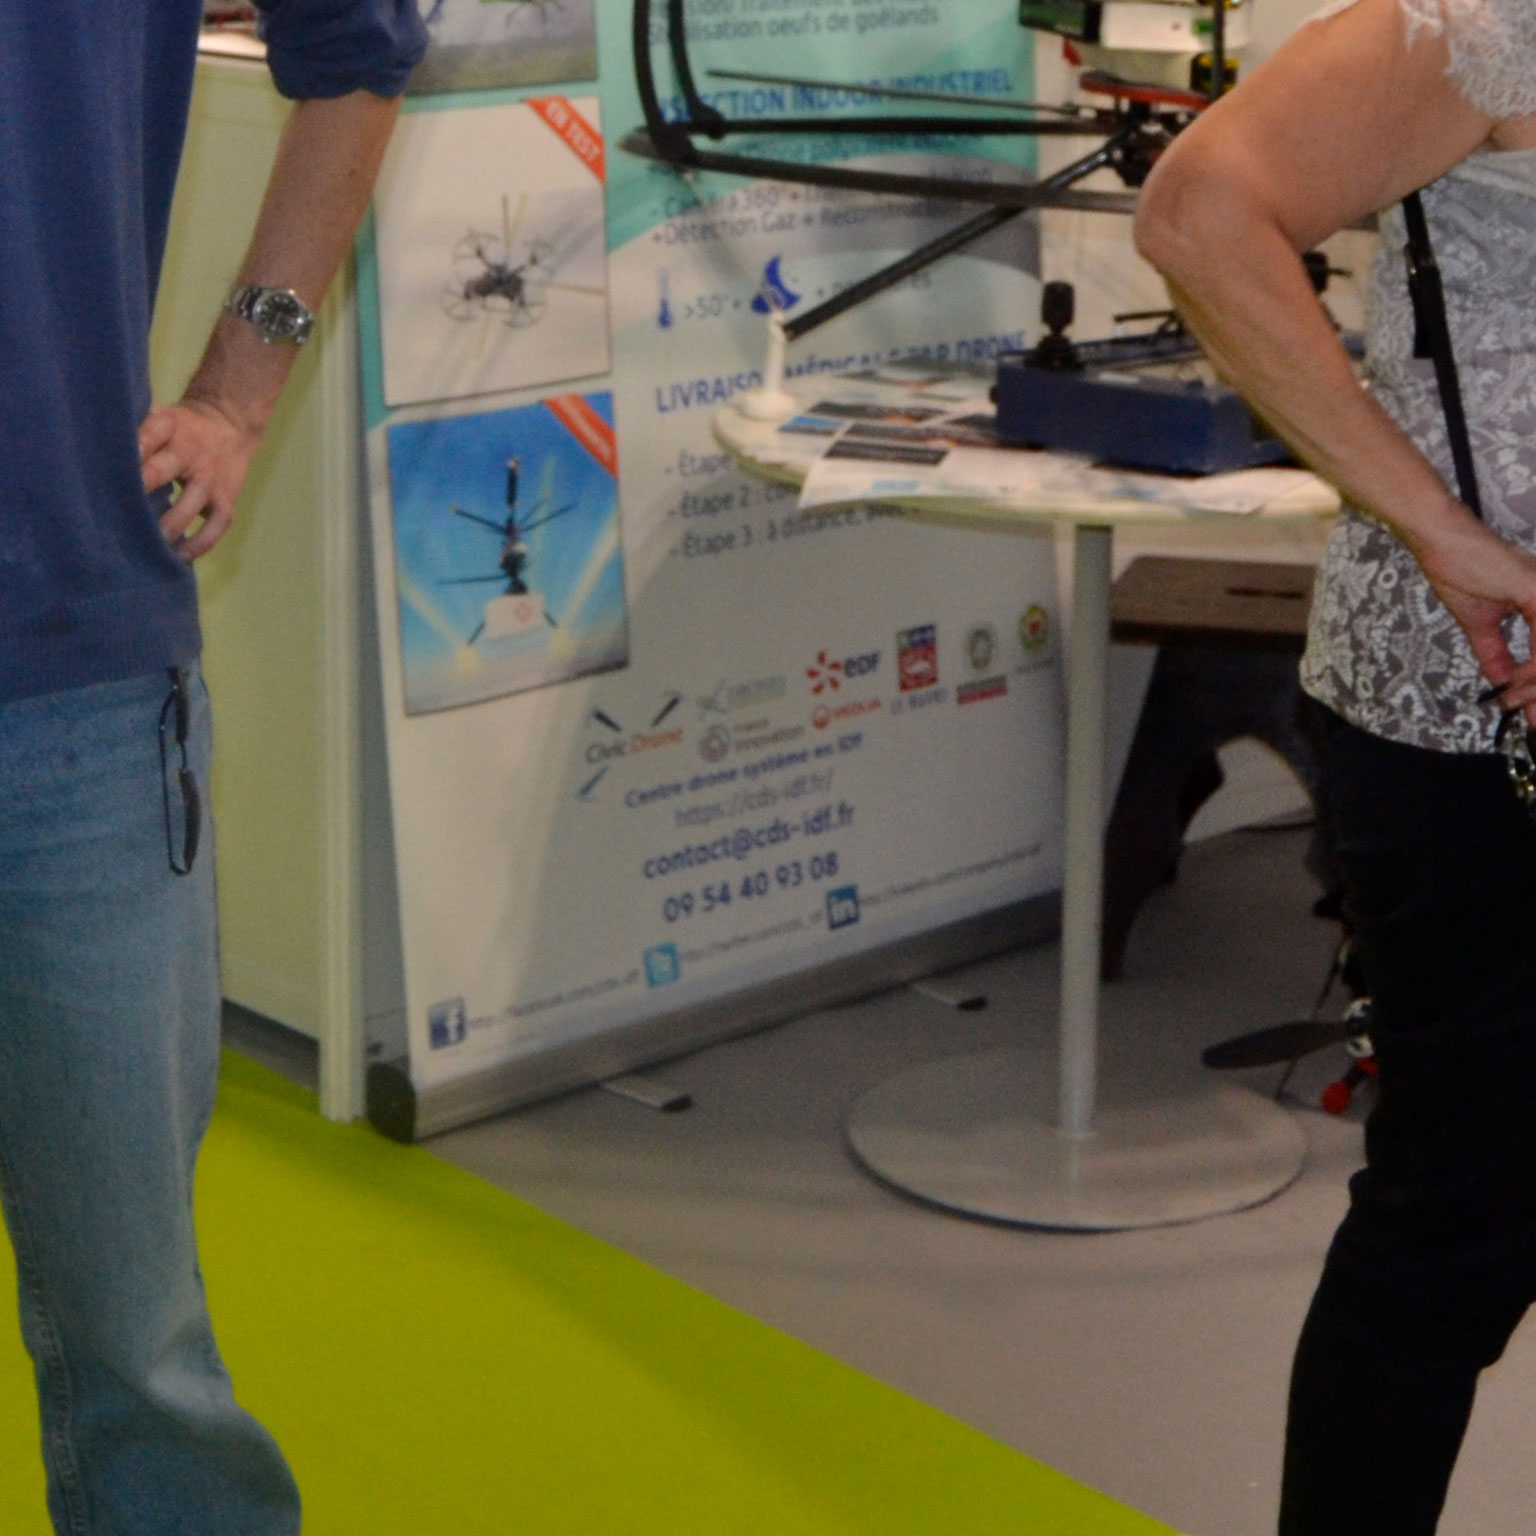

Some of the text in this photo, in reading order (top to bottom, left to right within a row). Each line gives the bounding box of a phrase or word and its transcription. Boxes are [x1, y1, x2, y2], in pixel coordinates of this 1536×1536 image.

[663, 890, 694, 923] 09
[702, 877, 732, 912] 54
[740, 868, 768, 900] 40
[777, 860, 804, 888] 93
[809, 851, 840, 879] 08
